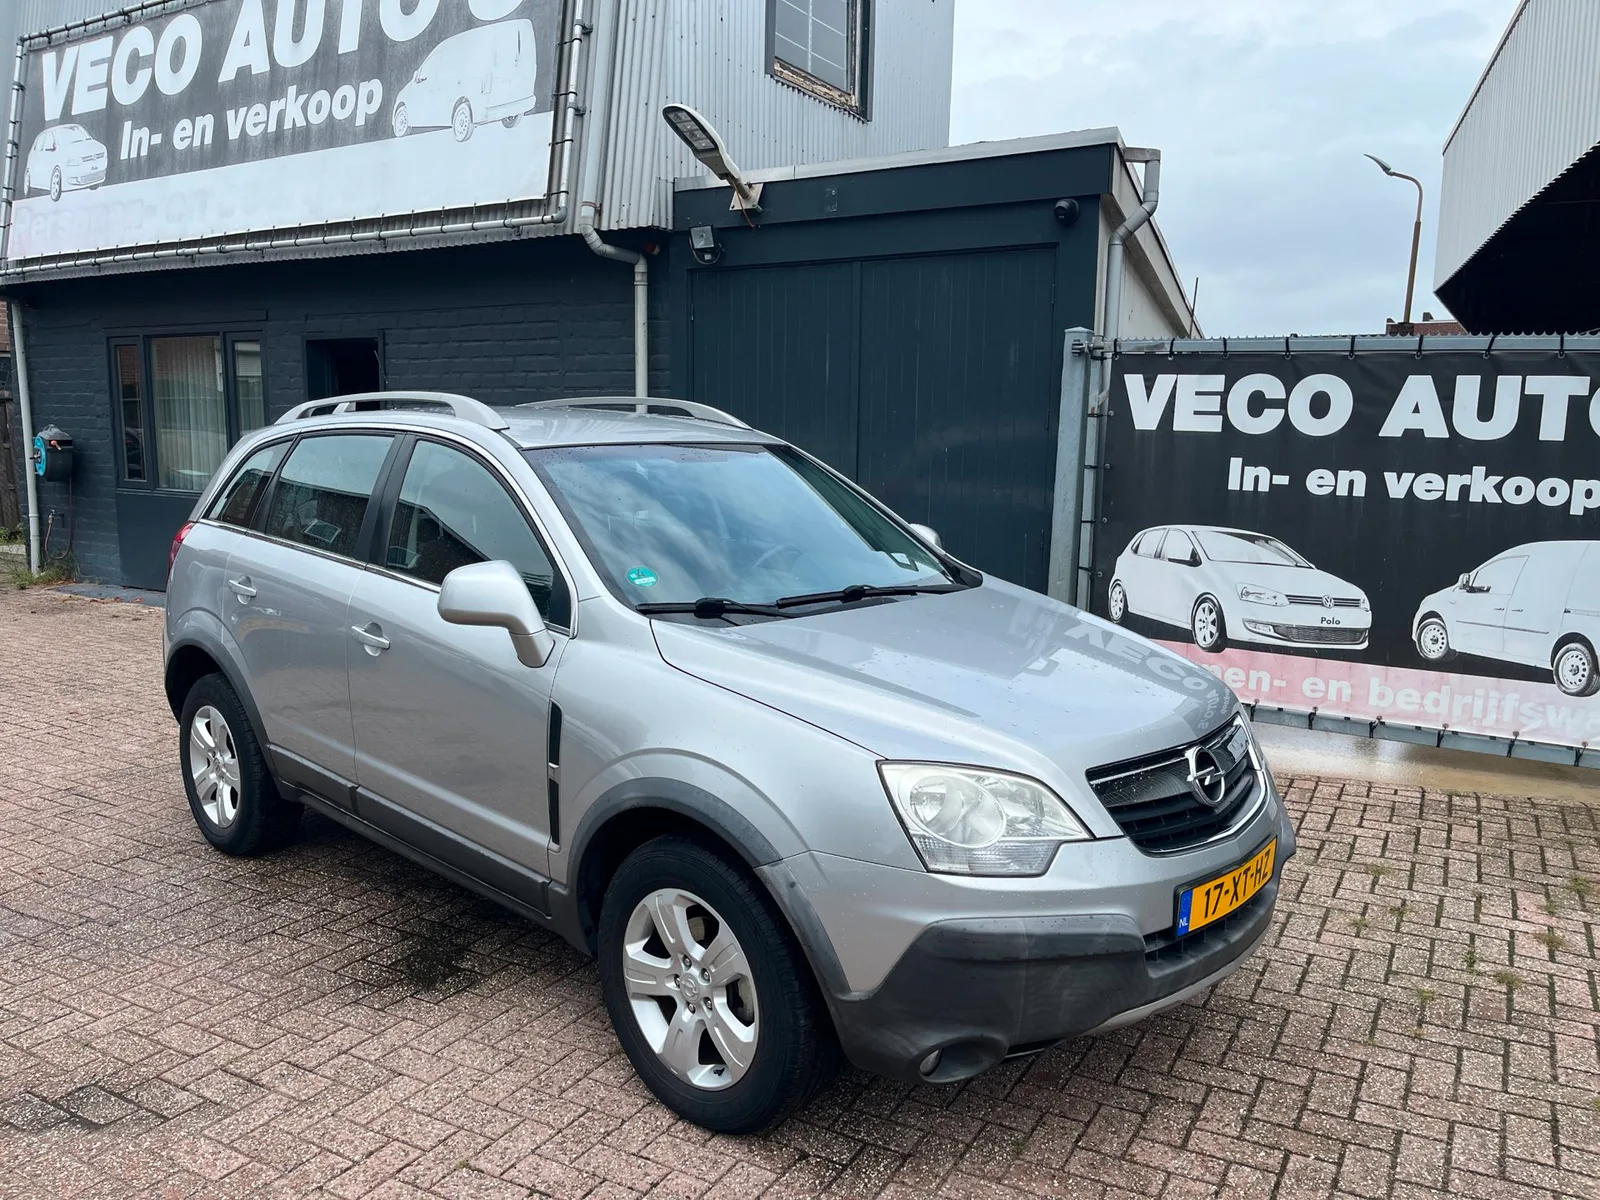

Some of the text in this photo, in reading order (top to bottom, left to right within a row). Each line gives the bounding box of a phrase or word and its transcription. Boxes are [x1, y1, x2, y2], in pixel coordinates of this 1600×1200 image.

[42, 0, 523, 121] VECO AUTO
[120, 78, 383, 160] In- en verkoop
[1123, 373, 1600, 441] VECO AUT
[1228, 457, 1600, 516] In- en verkoop
[1320, 616, 1341, 625] Polo
[1302, 677, 1351, 702] en
[1204, 848, 1271, 919] 17-XT-HZ
[1179, 916, 1189, 928] NL
